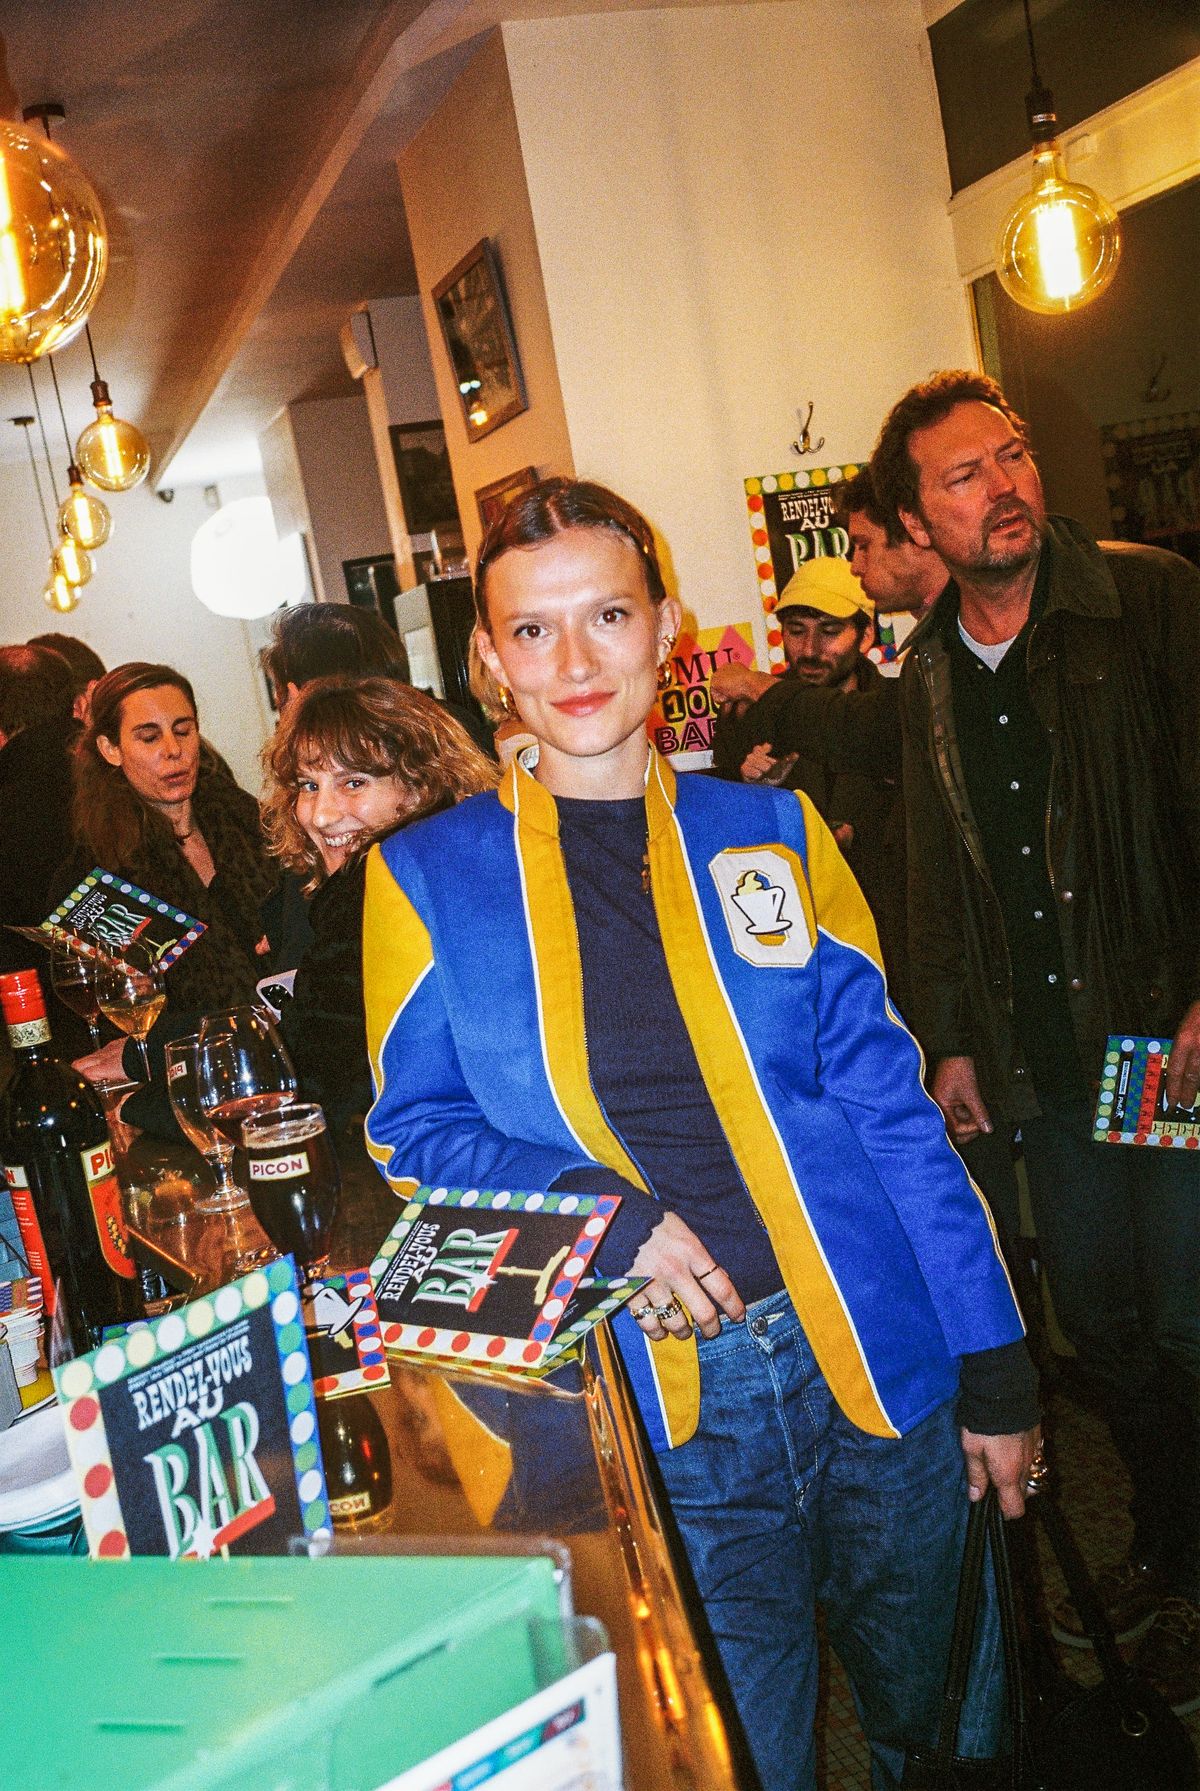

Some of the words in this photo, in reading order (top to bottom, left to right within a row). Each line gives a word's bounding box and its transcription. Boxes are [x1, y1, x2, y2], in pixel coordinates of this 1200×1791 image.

[800, 515, 829, 532] AU
[662, 685, 720, 723] 10
[87, 904, 149, 949] BAR
[252, 1158, 303, 1176] PICON
[382, 1223, 441, 1301] RENDEZ-VOUS
[411, 1228, 513, 1311] BAR
[412, 1246, 439, 1284] AU
[132, 1335, 253, 1431] RENDEZ-VOUS
[171, 1386, 225, 1439] AU
[143, 1402, 272, 1562] BAR
